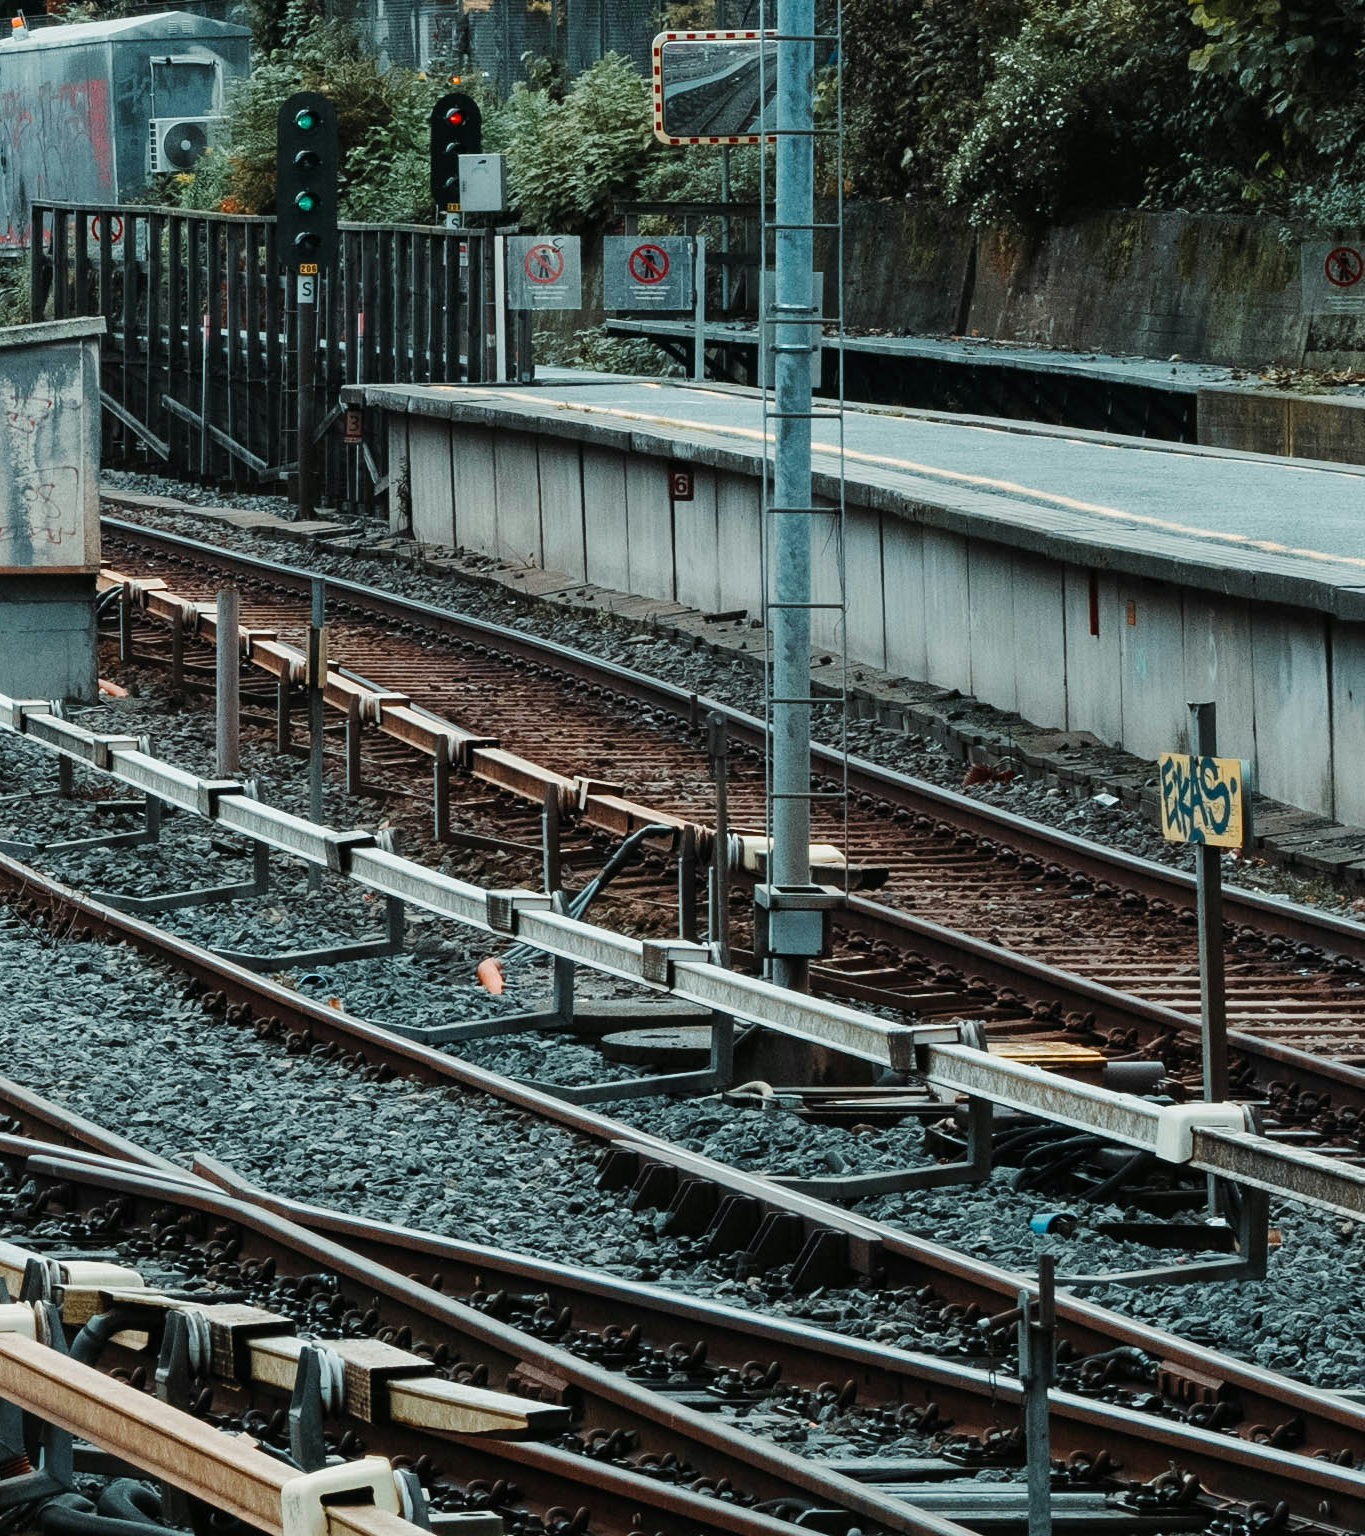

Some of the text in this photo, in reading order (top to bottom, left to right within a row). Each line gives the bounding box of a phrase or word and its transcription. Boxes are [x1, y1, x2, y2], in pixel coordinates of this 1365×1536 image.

[301, 264, 317, 273] 206
[302, 281, 312, 297] S
[348, 415, 359, 432] 3
[675, 475, 688, 494] 6
